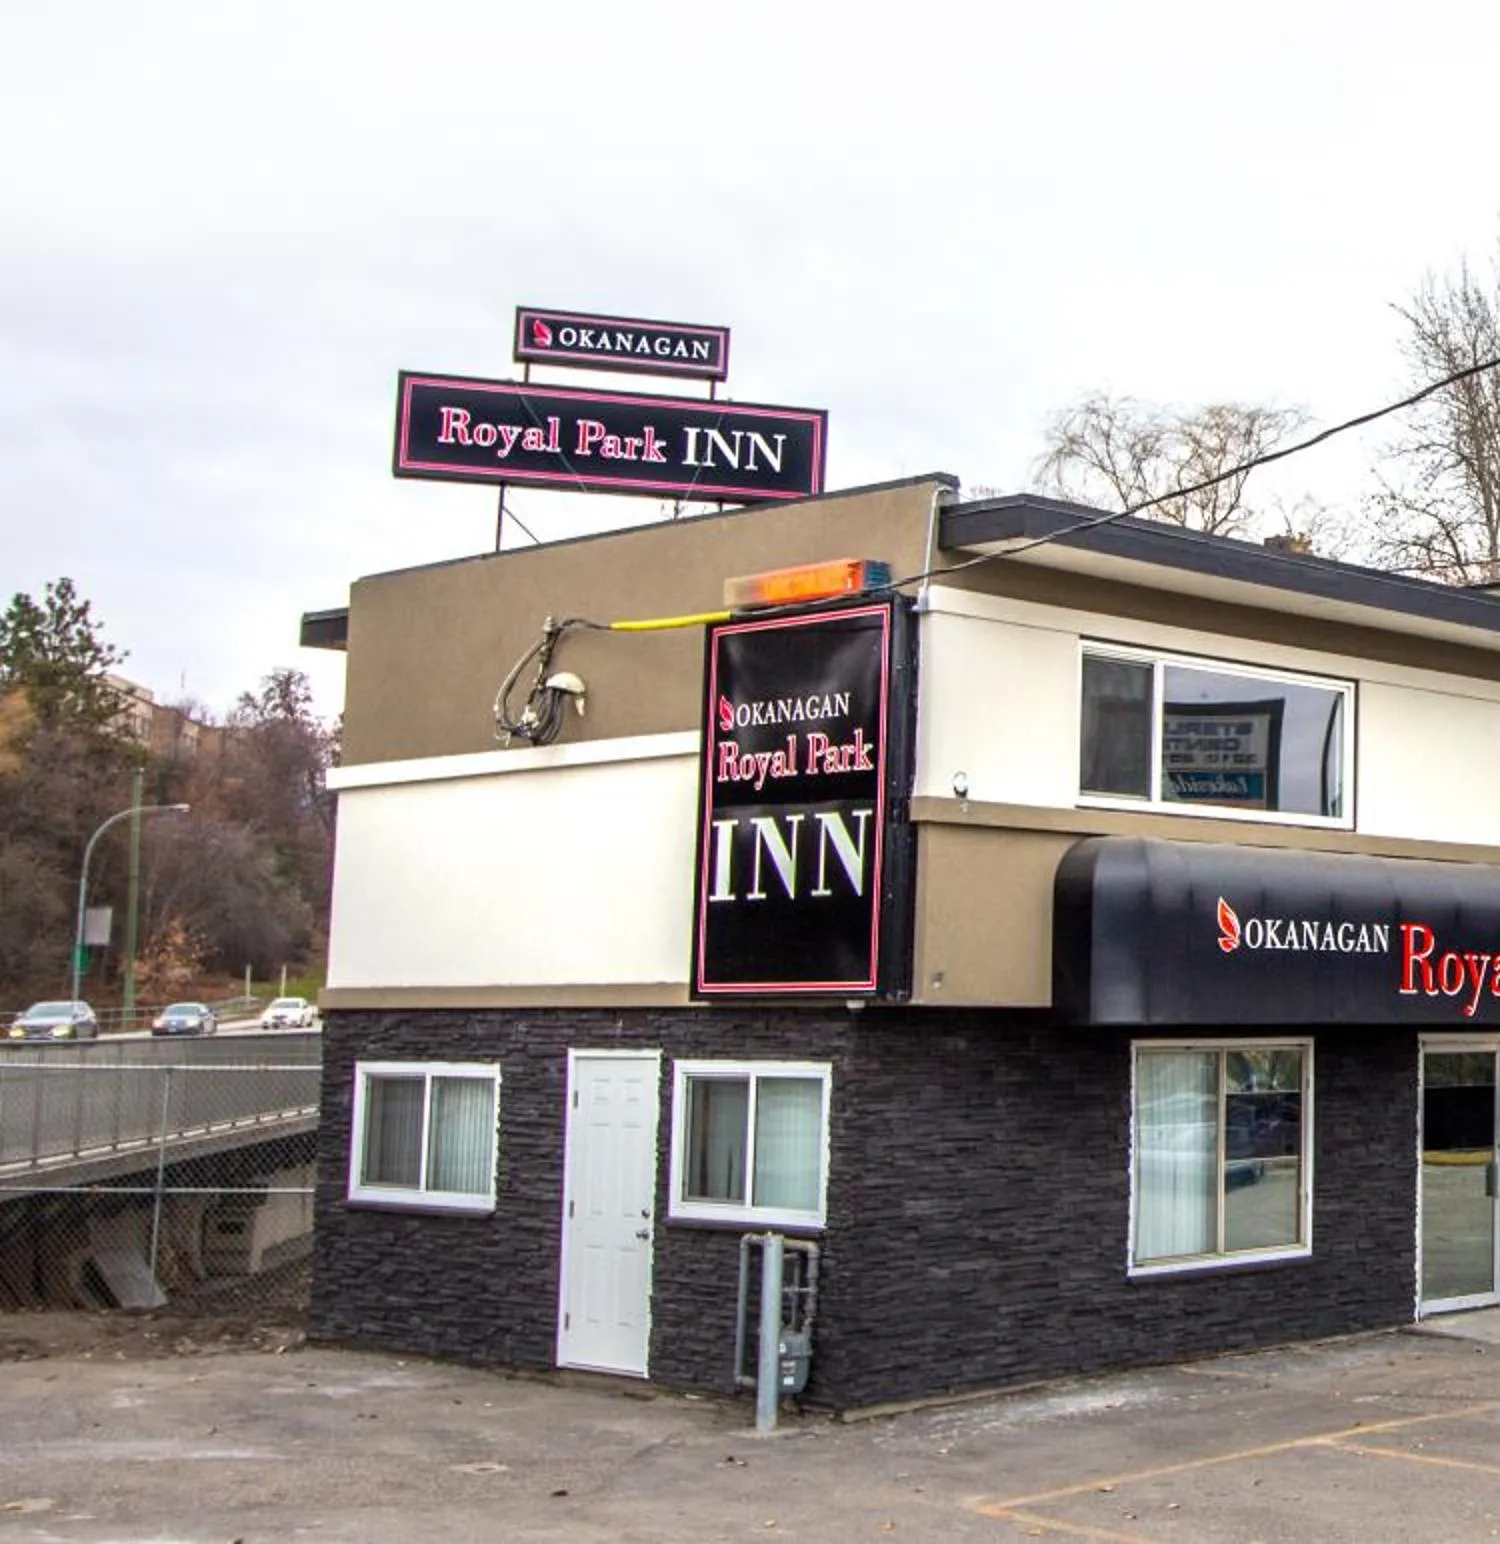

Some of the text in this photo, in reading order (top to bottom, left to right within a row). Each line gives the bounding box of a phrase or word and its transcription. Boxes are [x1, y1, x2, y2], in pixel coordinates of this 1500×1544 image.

[558, 328, 711, 360] OKANAGAN
[437, 406, 787, 473] Royal Park INN
[736, 692, 851, 728] OKANAGAN
[717, 728, 874, 790] Royal Park
[708, 808, 873, 902] INN
[1244, 917, 1390, 954] OKANAGAN
